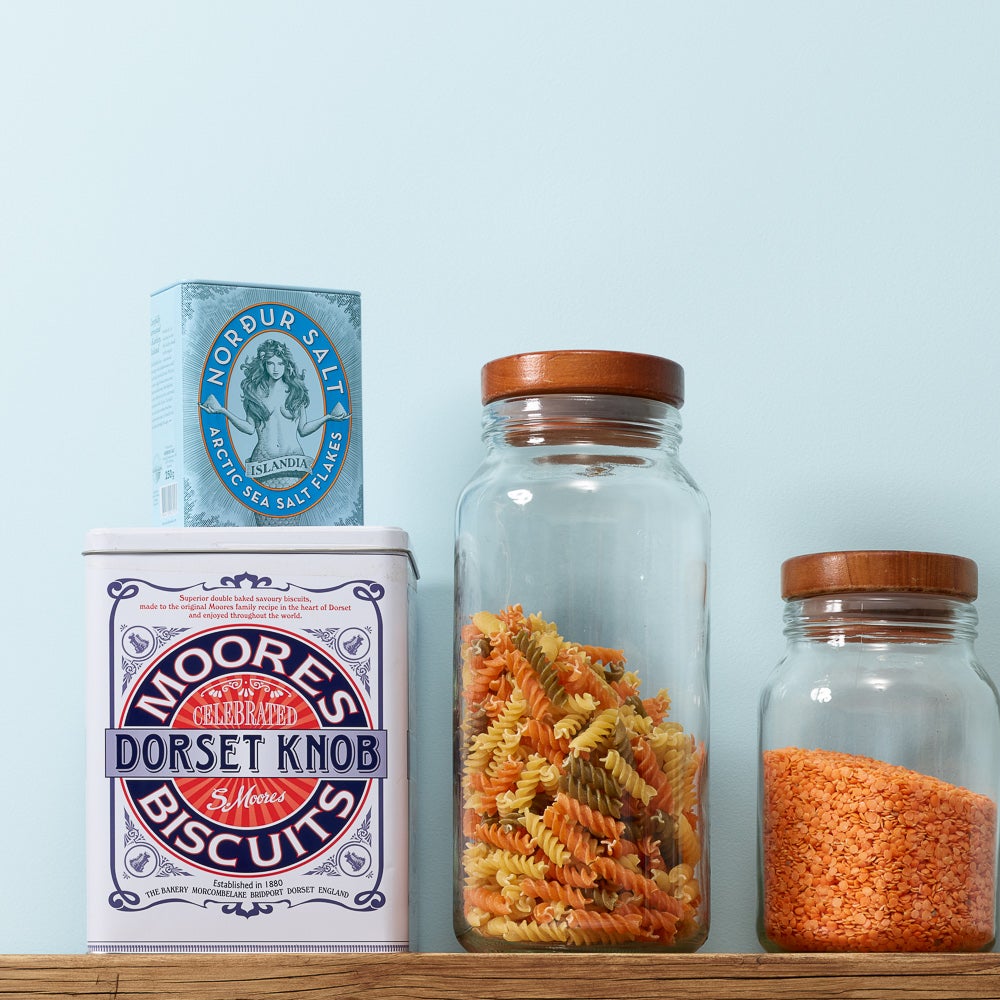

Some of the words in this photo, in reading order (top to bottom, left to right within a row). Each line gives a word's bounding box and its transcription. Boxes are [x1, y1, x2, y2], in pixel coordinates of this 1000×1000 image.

[206, 308, 295, 386] NORÐUR
[302, 329, 344, 394] SALT
[210, 427, 242, 486] ARCTIC
[242, 486, 270, 508] SEA
[276, 487, 311, 509] SALT
[311, 432, 342, 490] FLAKES
[251, 458, 308, 476] ISLANDIA
[179, 594, 209, 602] Superior
[180, 603, 207, 611] original
[202, 612, 229, 620] enjoyed
[230, 612, 267, 620] throughout
[136, 635, 358, 723] MOORES
[193, 700, 298, 727] CELEBRATED
[115, 734, 265, 774] DORSET
[277, 734, 381, 774] KNOB
[137, 782, 355, 867] BISCUITS
[145, 888, 160, 899] THE
[161, 886, 189, 894] BAKERY
[192, 887, 247, 899] MORCOMBELAKE
[250, 888, 284, 899] BRIDPORT
[287, 886, 315, 895] DORSET
[318, 887, 350, 899] ENGLAND
[213, 879, 254, 889] Established
[255, 881, 263, 889] in
[265, 879, 283, 888] 1880
